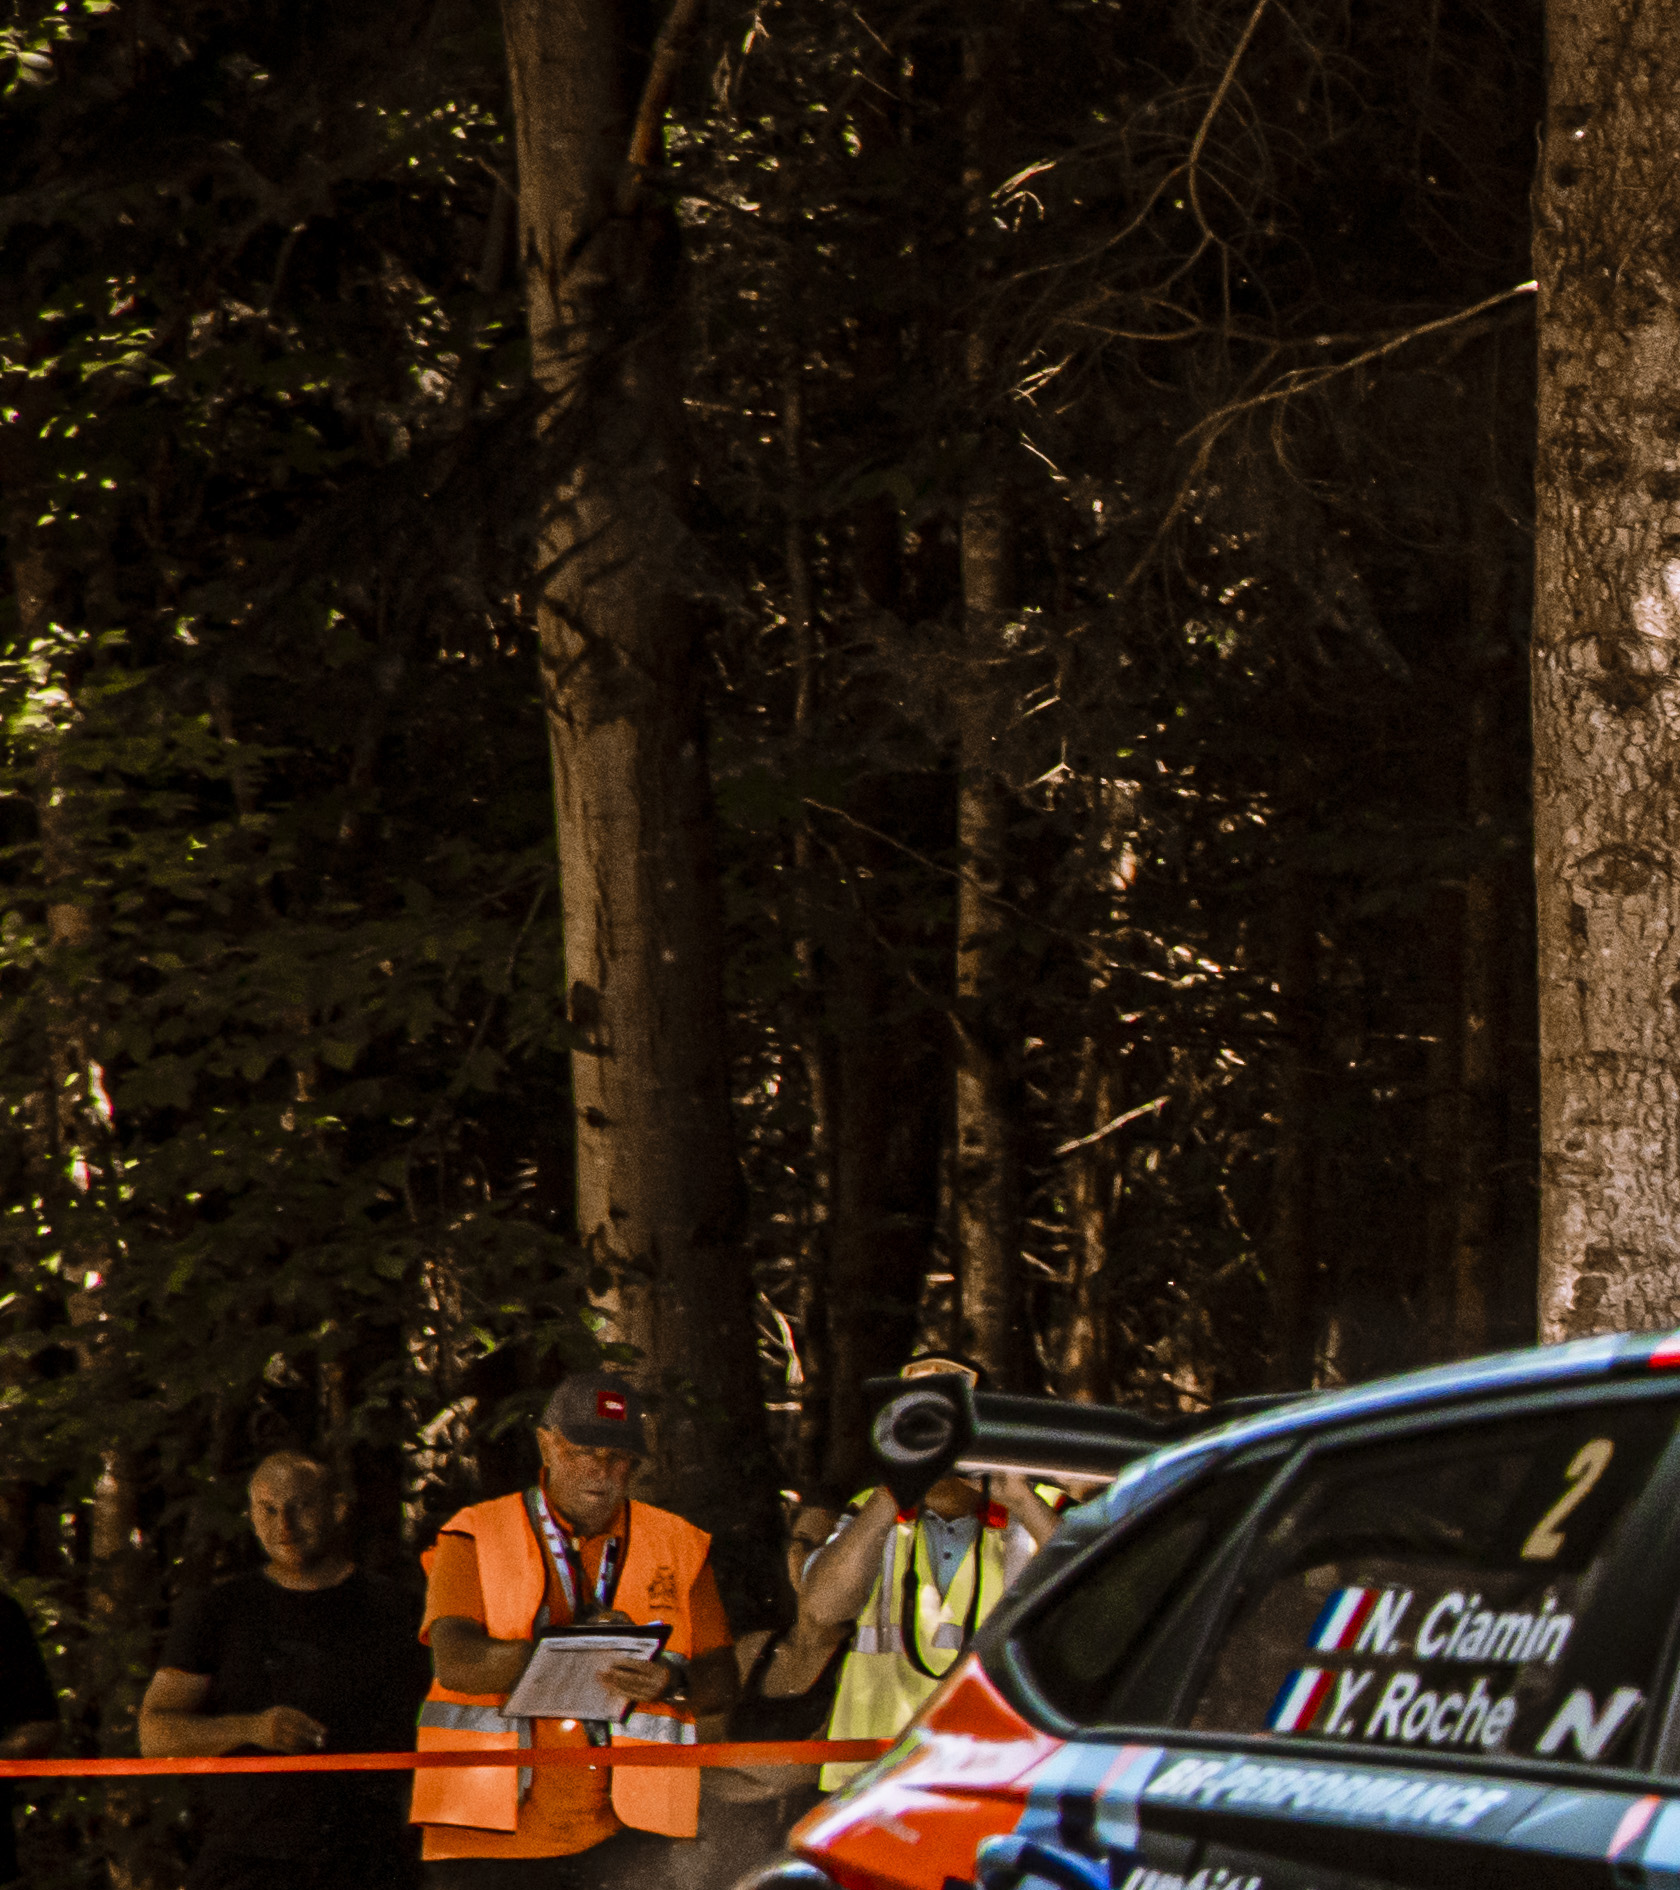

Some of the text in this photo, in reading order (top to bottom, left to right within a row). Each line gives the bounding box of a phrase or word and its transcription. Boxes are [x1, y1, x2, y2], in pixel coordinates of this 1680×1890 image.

[1520, 1438, 1615, 1560] 2
[1354, 1588, 1575, 1664] N. Ciamin
[1324, 1668, 1517, 1747] Y. Roche
